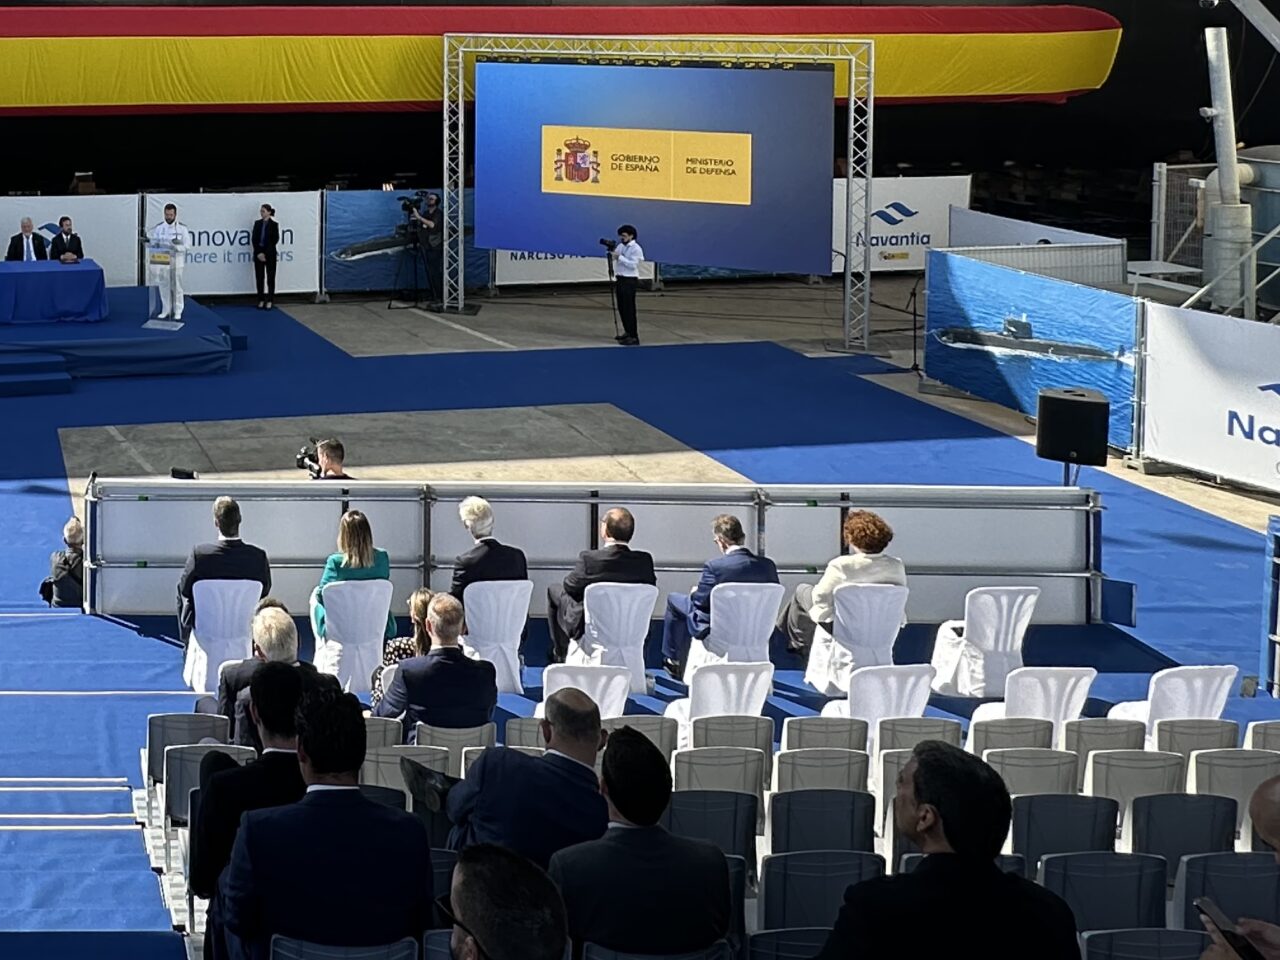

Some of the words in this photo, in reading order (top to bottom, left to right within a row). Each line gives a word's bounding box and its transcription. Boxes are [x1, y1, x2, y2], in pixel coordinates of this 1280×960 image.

[610, 153, 660, 164] GOBIERNO
[685, 157, 734, 167] MINISTERIO
[610, 163, 623, 171] DE
[625, 162, 660, 173] ESPAÑA
[685, 166, 697, 174] DE
[699, 167, 737, 176] DEFENSA
[188, 228, 294, 246] nnovan
[185, 249, 218, 264] here
[223, 250, 233, 263] it
